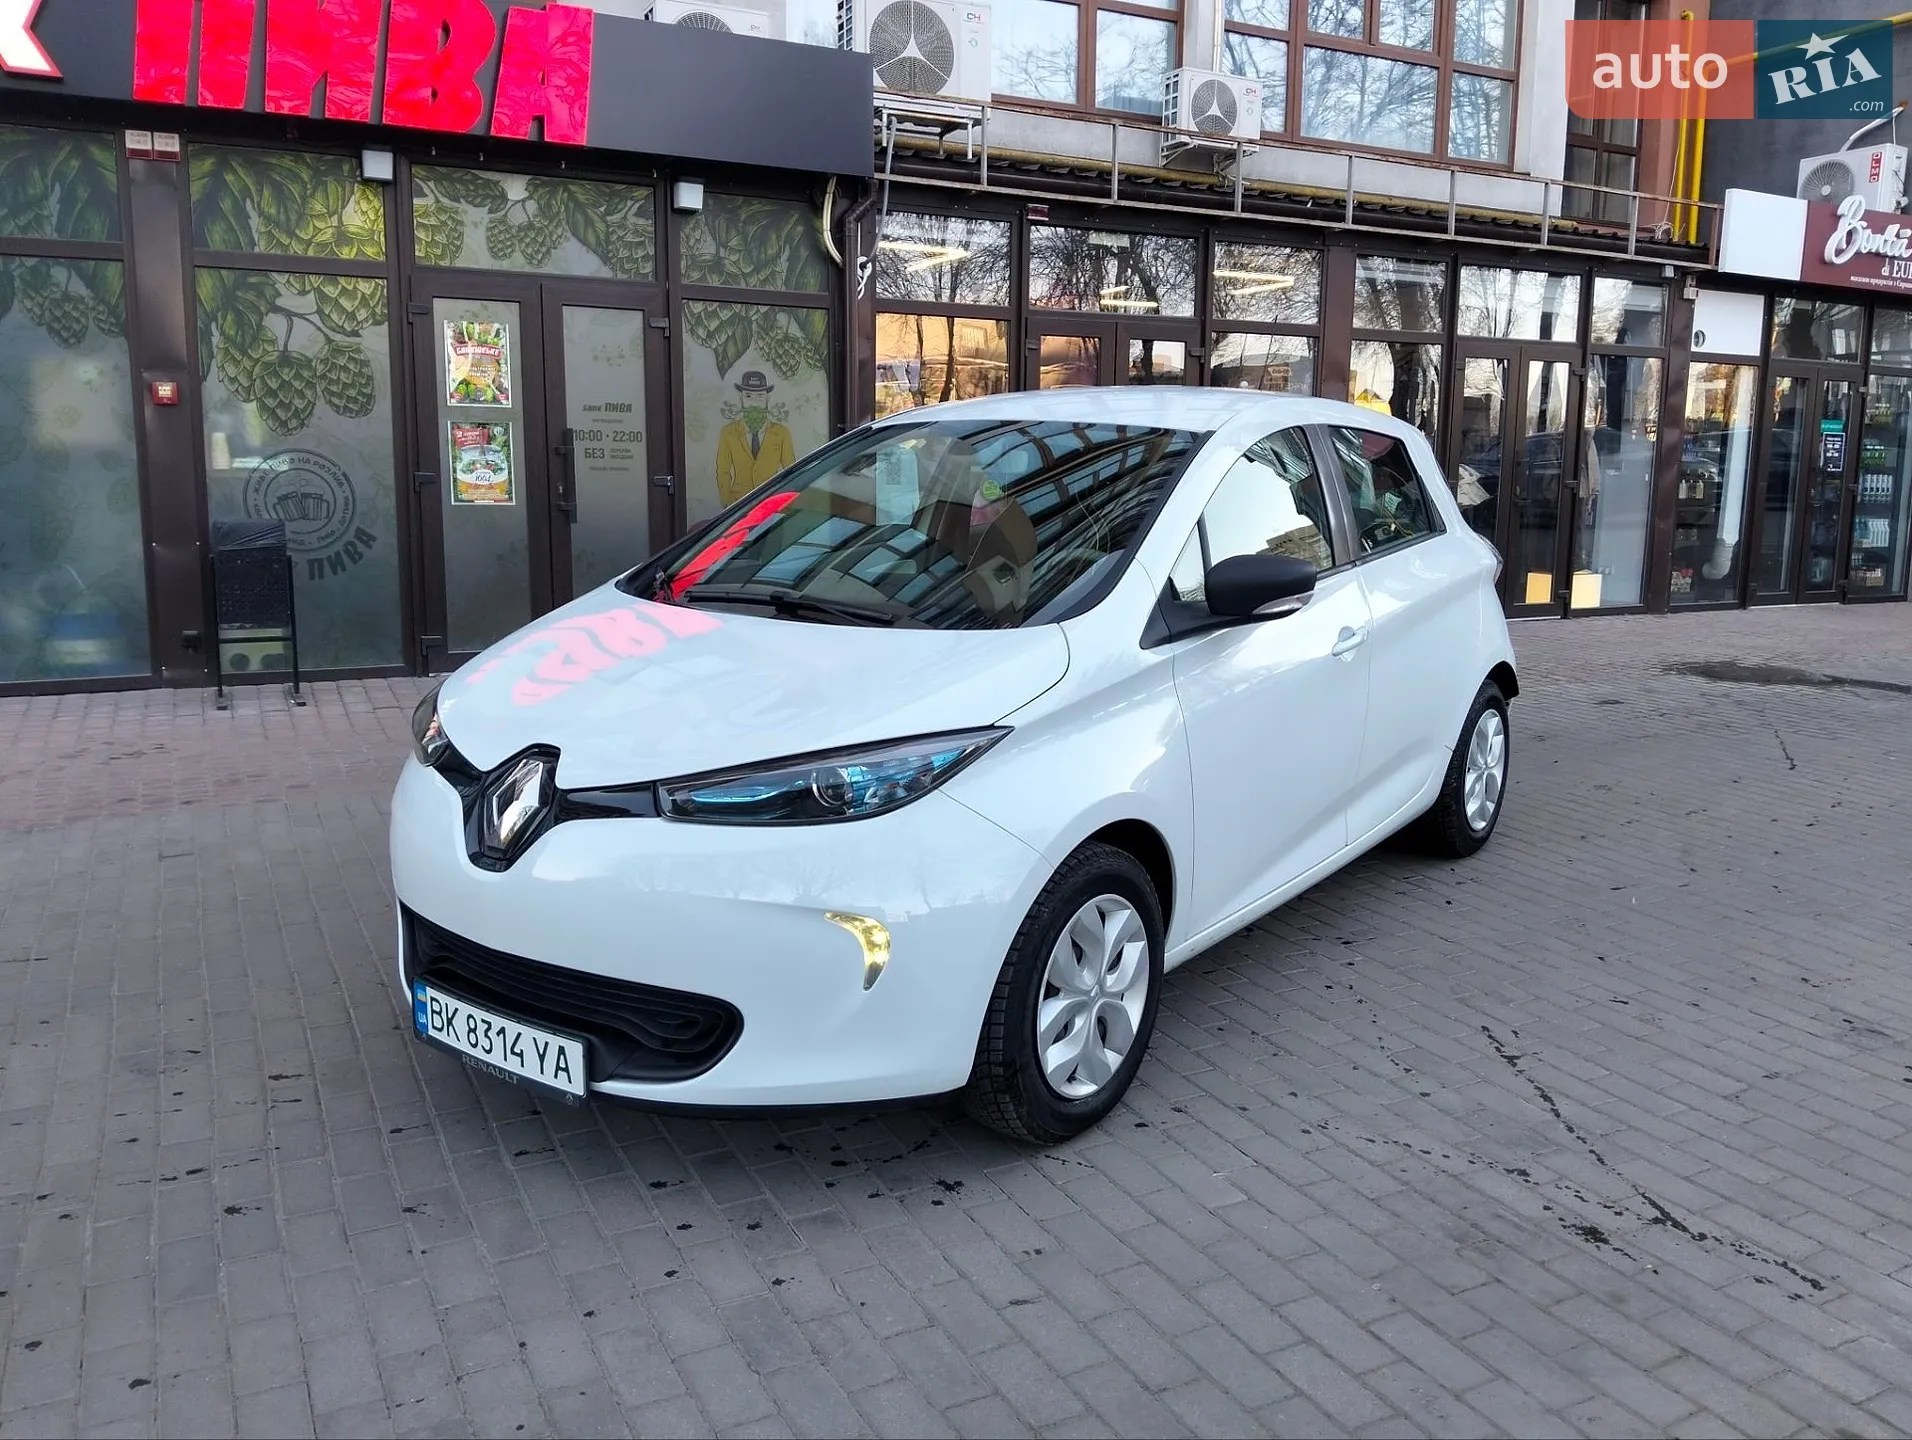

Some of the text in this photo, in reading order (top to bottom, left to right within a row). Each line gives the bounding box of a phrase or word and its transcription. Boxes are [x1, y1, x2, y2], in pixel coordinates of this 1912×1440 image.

[966, 12, 981, 21] CH
[604, 402, 632, 413] ПИВА
[574, 429, 642, 442] 10:00 22:00
[584, 448, 605, 459] БЕЗ
[306, 525, 378, 581] ПИВА
[418, 1012, 427, 1024] UA
[429, 995, 573, 1085] BK 8314 YA
[461, 1053, 521, 1085] RENAULT
